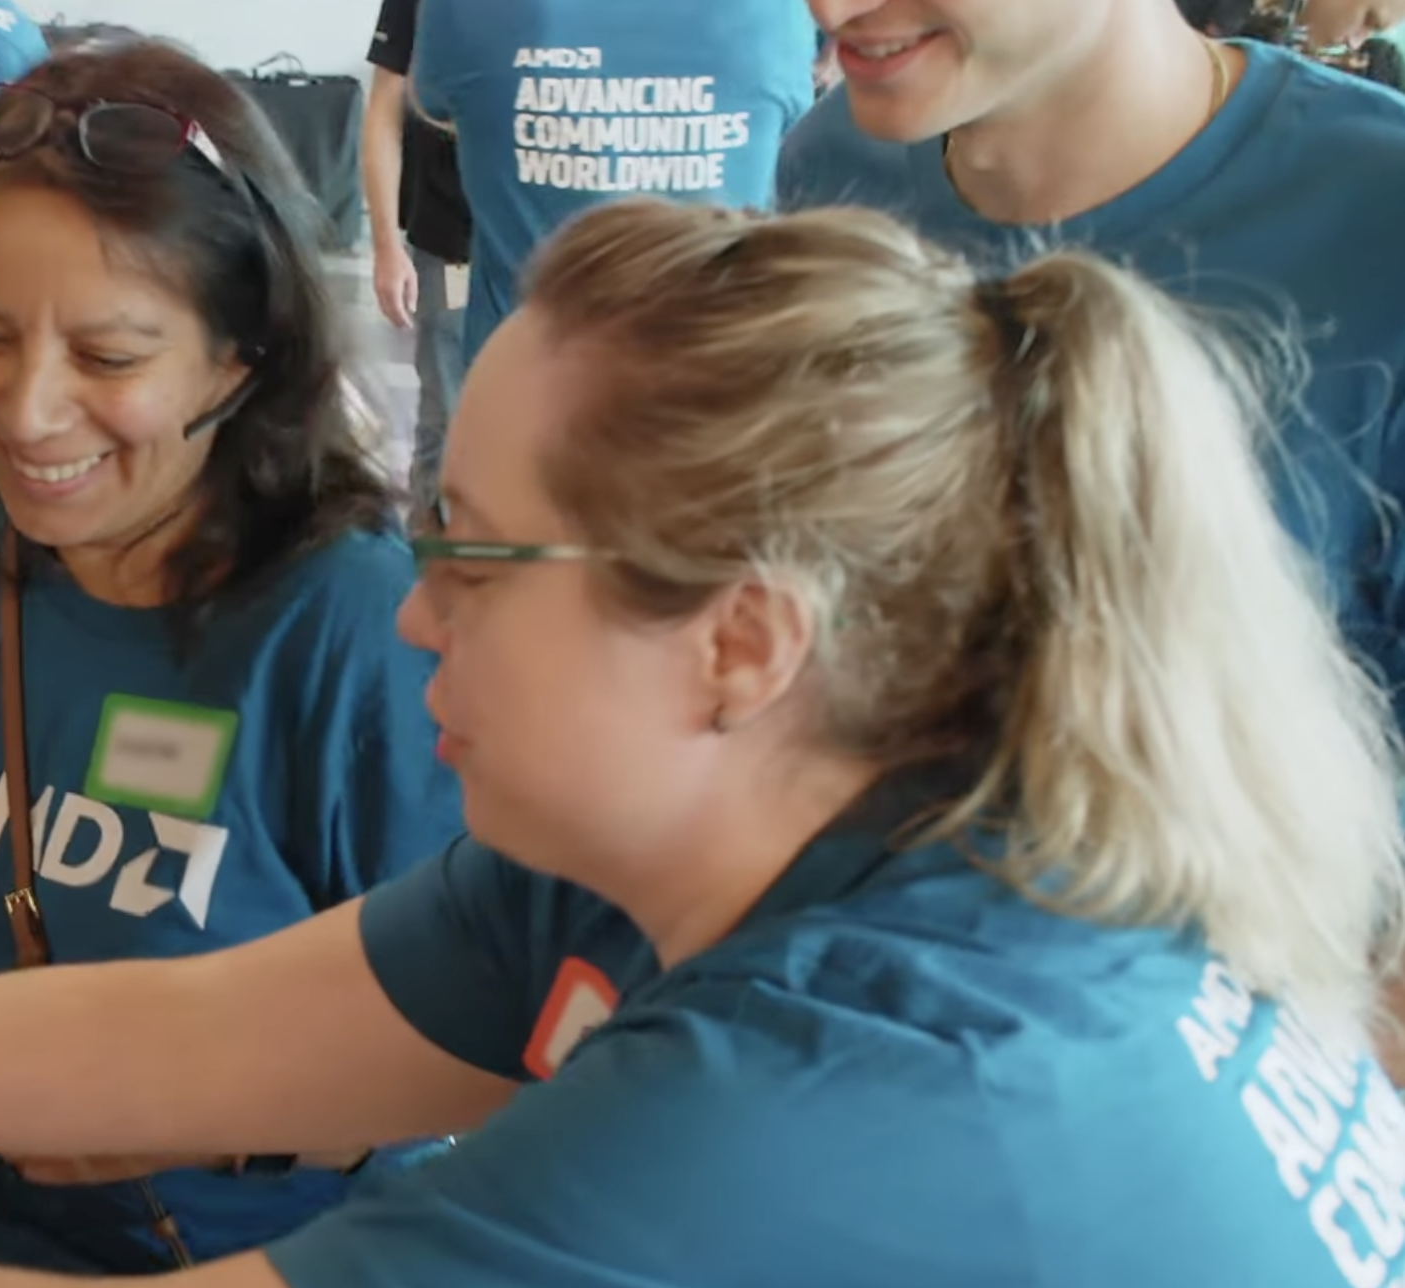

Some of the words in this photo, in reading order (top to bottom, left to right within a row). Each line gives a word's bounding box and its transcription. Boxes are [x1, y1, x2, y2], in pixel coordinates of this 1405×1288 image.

[512, 47, 579, 69] AMD
[514, 76, 714, 114] ADVANCING
[513, 112, 750, 152] COMMUNITIES
[515, 148, 725, 192] WORLDWIDE
